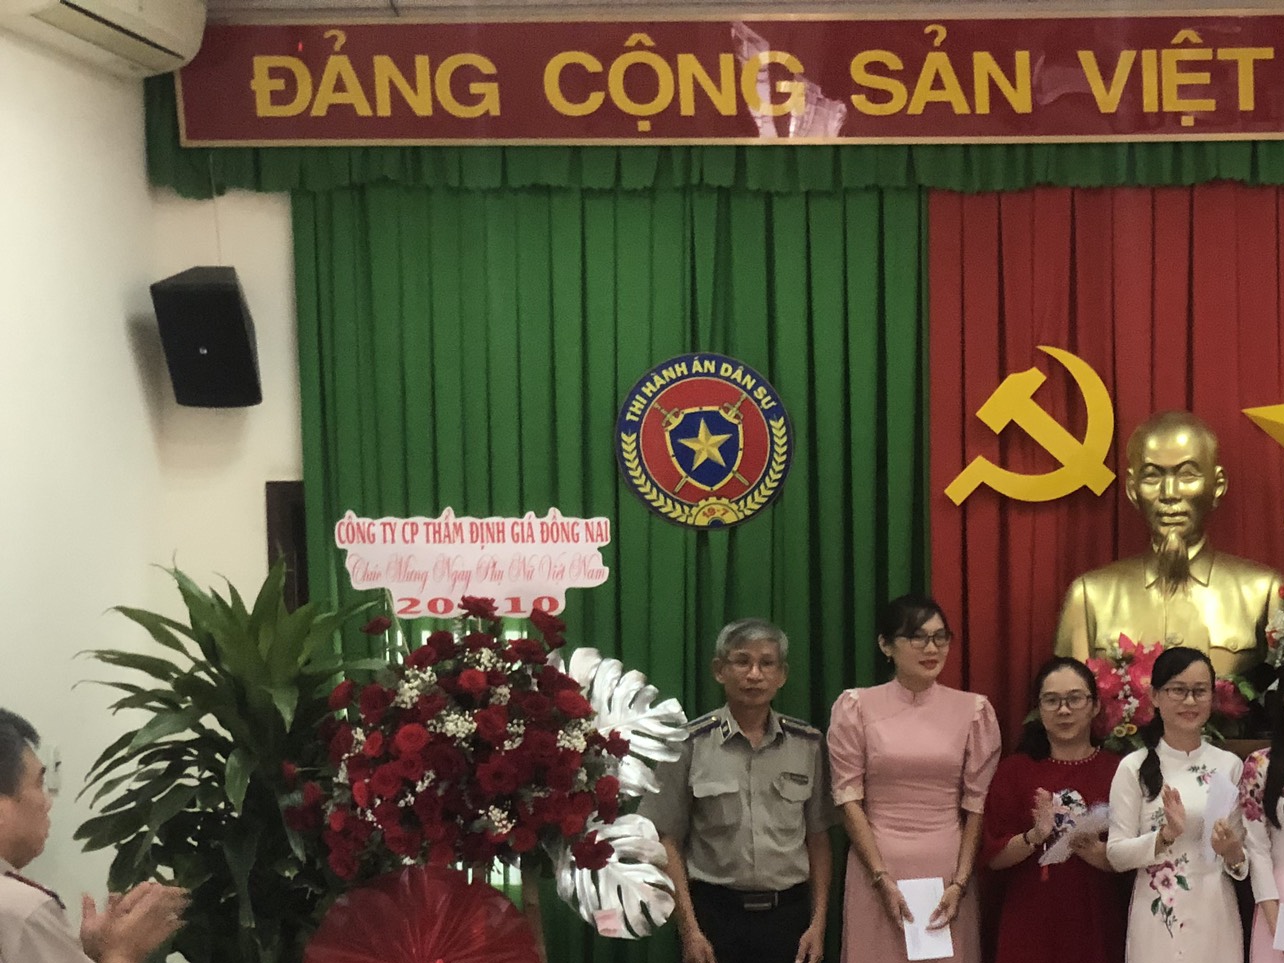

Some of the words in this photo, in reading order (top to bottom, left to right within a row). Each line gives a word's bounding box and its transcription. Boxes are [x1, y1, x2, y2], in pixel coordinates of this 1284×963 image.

[250, 29, 500, 118] ĐẢNG
[543, 32, 806, 132] CỘNG
[849, 23, 1033, 115] SẢN
[1077, 29, 1274, 126] VIỆT
[626, 395, 646, 422] THI
[641, 362, 689, 396] HÀNH
[337, 515, 376, 544] CÔNG
[380, 521, 397, 544] TY
[401, 521, 419, 544] CP
[511, 514, 536, 543] GIÁ
[584, 520, 609, 542] NAI
